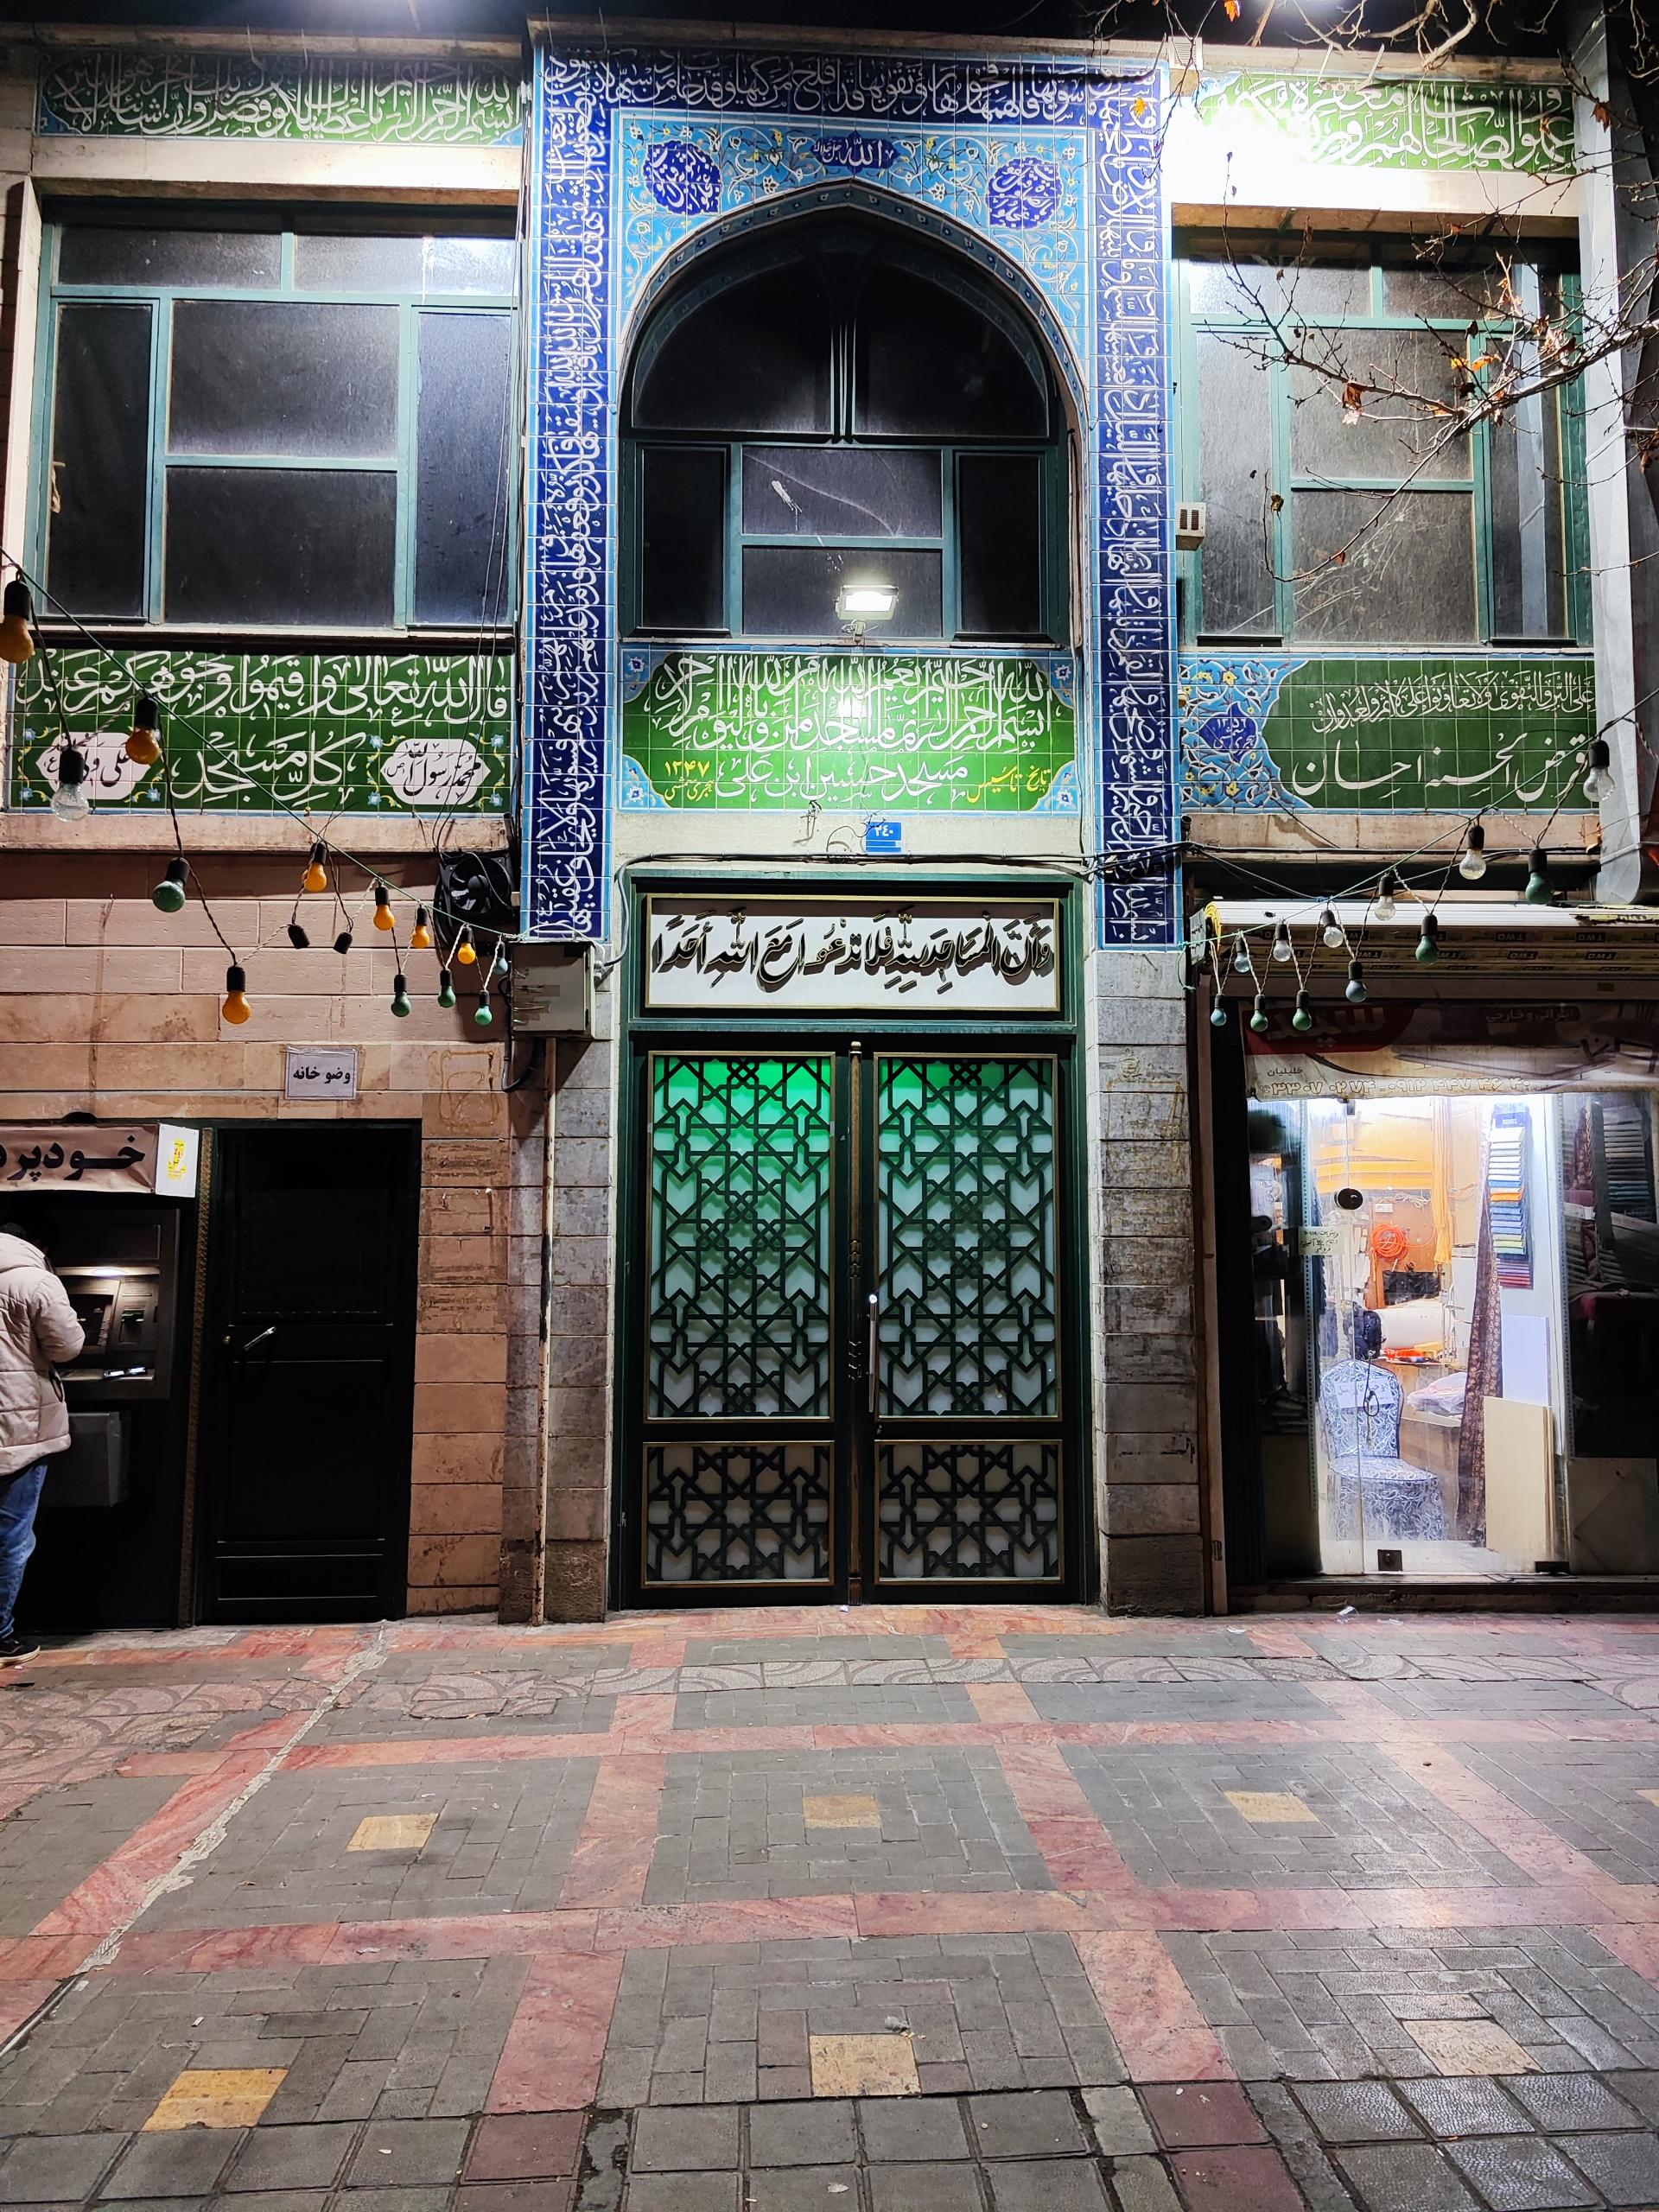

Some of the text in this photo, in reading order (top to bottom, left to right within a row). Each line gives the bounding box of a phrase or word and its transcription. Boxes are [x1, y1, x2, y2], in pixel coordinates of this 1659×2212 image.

[845, 137, 883, 168] الله
[443, 654, 510, 724] قال
[169, 730, 367, 805] کل مسجد
[714, 753, 774, 798] علی
[880, 757, 969, 802] مسجد
[1026, 764, 1052, 792] تاریخ
[709, 912, 760, 987] الله
[293, 1066, 351, 1084] وضو خانه
